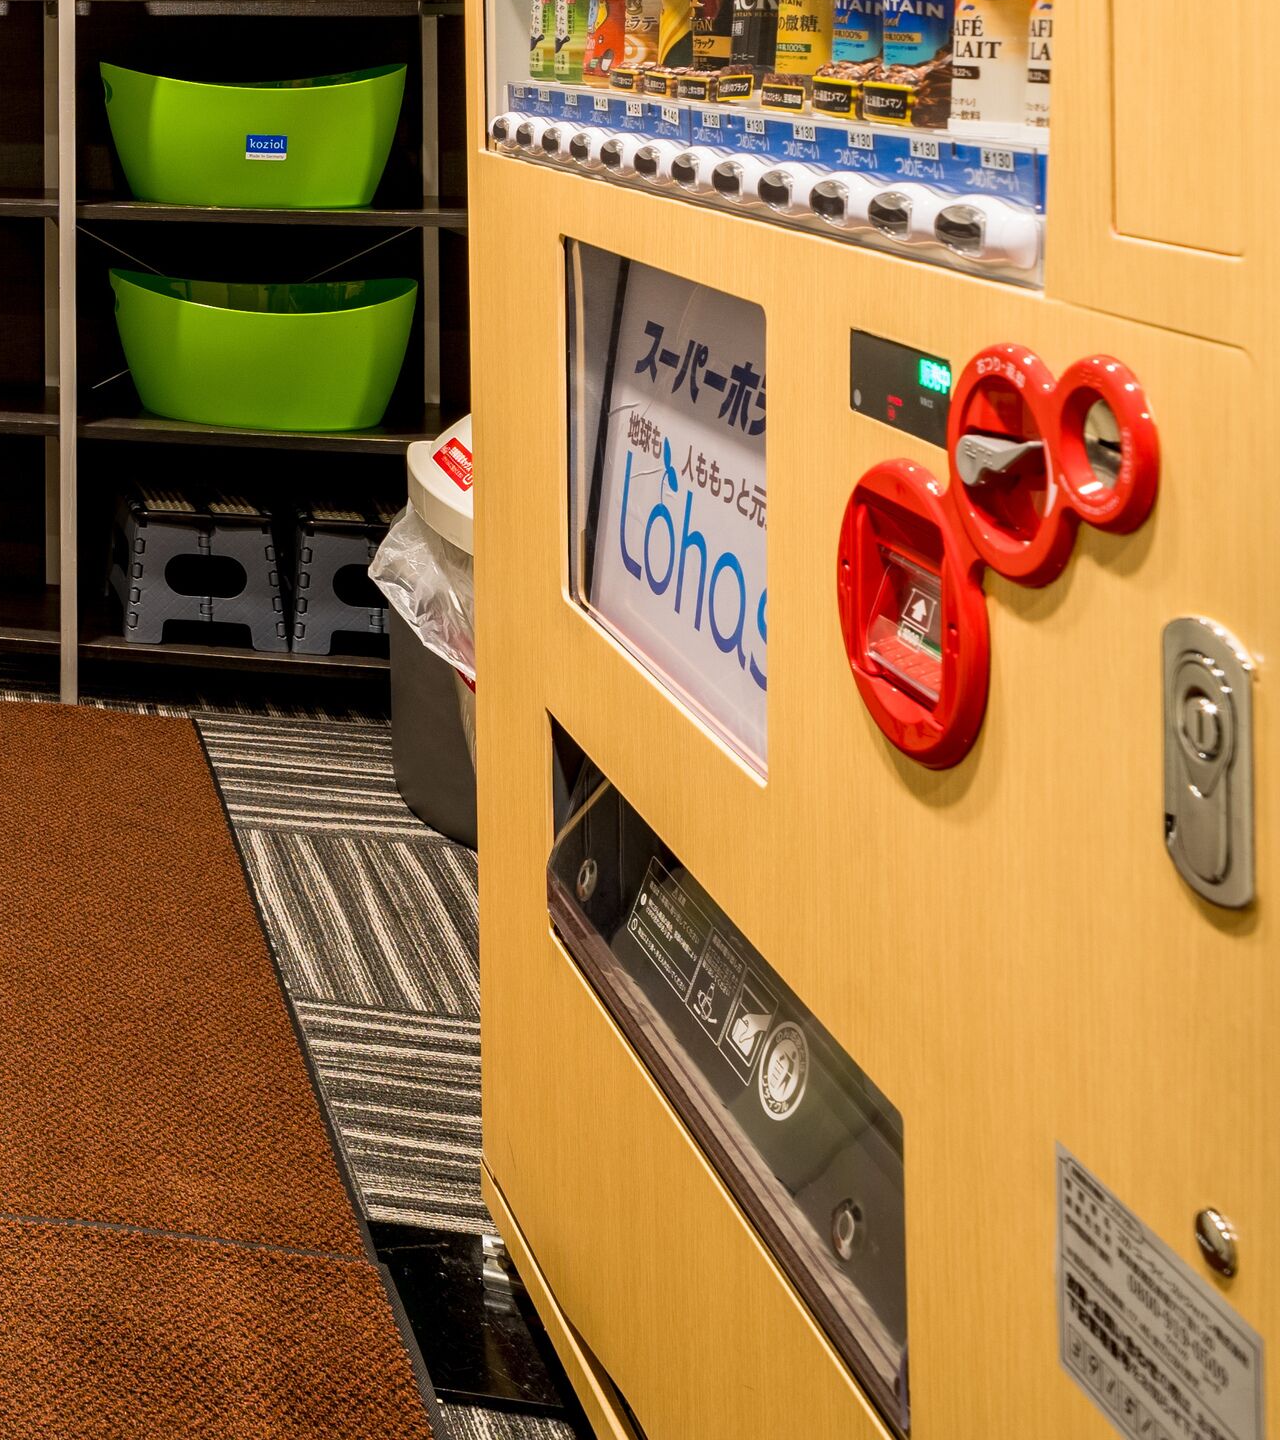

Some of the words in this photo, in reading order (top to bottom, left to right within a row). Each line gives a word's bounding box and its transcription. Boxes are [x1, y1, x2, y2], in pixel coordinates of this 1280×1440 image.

[955, 41, 1002, 59] LAIT
[594, 98, 608, 111] ¥140
[626, 103, 641, 116] ¥150
[662, 106, 679, 123] ¥140
[703, 114, 720, 127] ¥130
[746, 119, 765, 133] ¥130
[794, 124, 815, 140] ¥130
[249, 137, 285, 150] koziol
[849, 132, 871, 148] ¥130
[781, 141, 820, 160] つめた～い
[912, 141, 937, 157] ¥130
[834, 149, 878, 169] つめた～い
[983, 150, 1012, 169] ¥130
[895, 157, 945, 179] つめた～い
[963, 167, 1019, 192] つめた～い
[627, 410, 663, 459] 地球も
[681, 445, 767, 528] 人ももっと元
[762, 1074, 792, 1114] リサイクル
